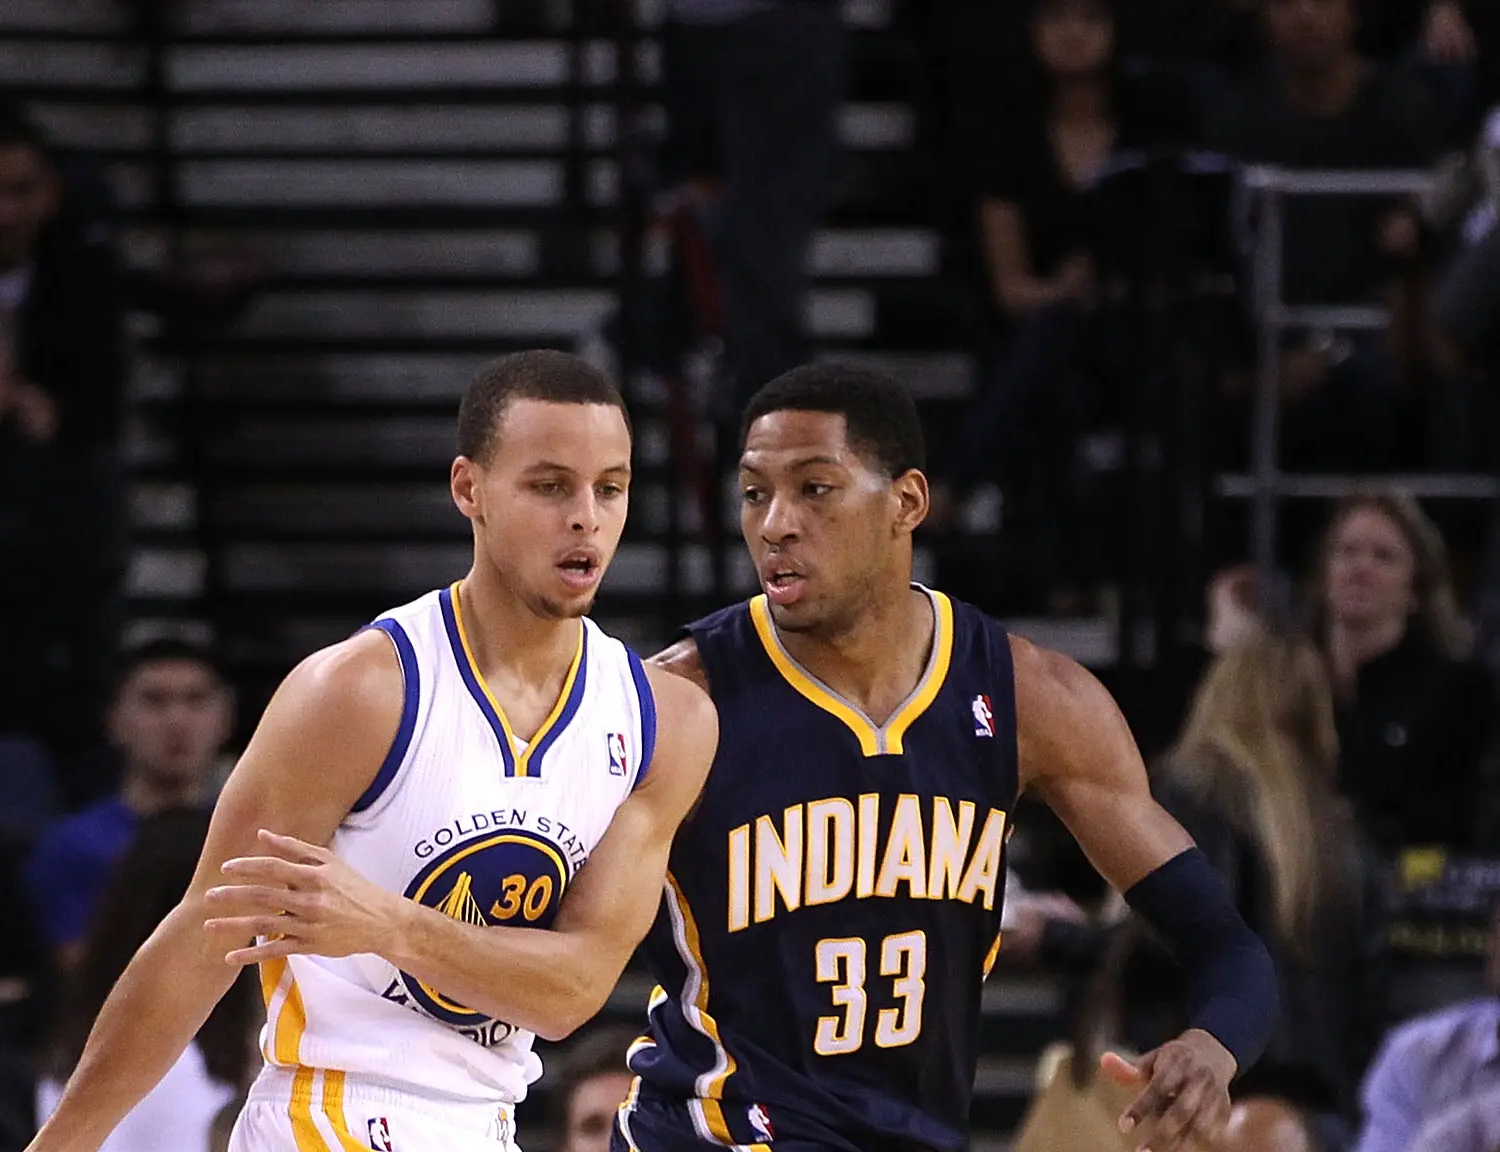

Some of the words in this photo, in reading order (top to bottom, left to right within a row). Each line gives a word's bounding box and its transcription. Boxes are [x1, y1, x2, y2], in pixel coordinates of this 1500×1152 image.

[414, 808, 528, 860] GOLDEN
[537, 816, 587, 872] STATE
[727, 793, 1007, 933] INDIANA
[490, 873, 553, 922] 30
[814, 929, 927, 1056] 33
